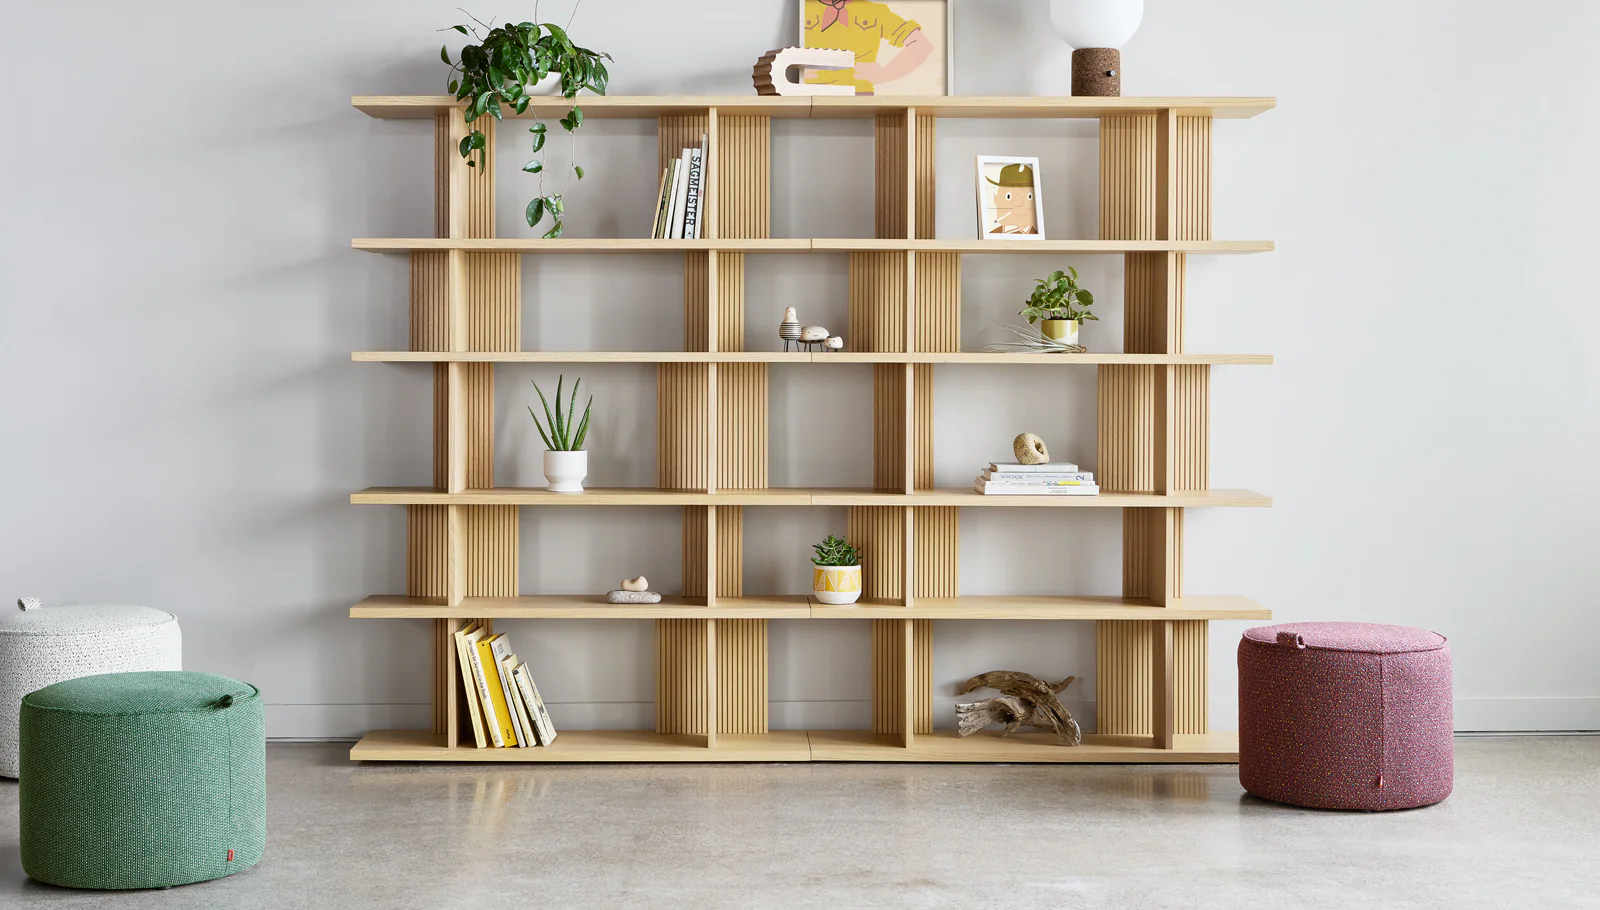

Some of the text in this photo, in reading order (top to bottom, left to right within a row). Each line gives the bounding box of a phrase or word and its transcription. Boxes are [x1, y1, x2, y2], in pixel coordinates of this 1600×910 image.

[685, 156, 701, 226] SAGMEISTER
[467, 639, 476, 657] Struggle
[474, 661, 482, 678] Survival
